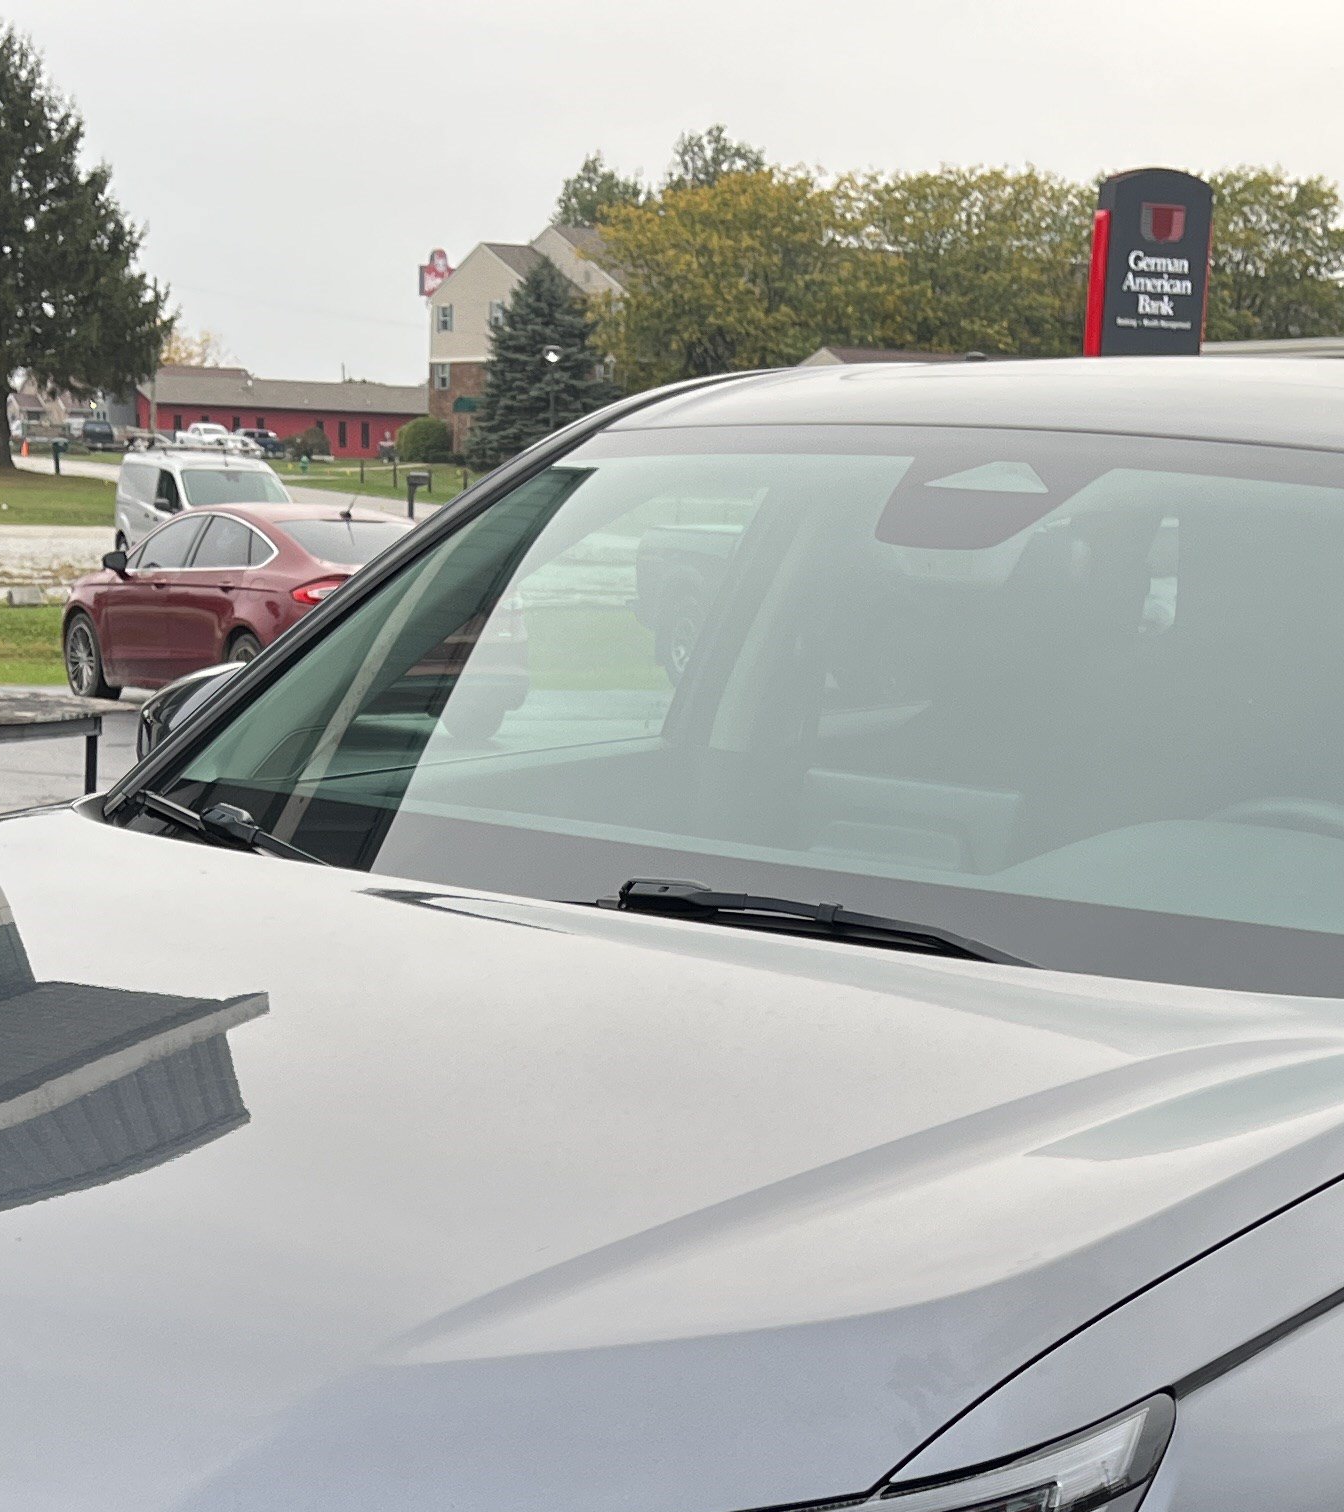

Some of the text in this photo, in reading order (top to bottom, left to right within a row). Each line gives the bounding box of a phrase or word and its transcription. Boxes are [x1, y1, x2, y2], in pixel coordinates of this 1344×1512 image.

[1128, 250, 1189, 274] German
[1122, 272, 1192, 295] American
[1137, 295, 1174, 316] Bank
